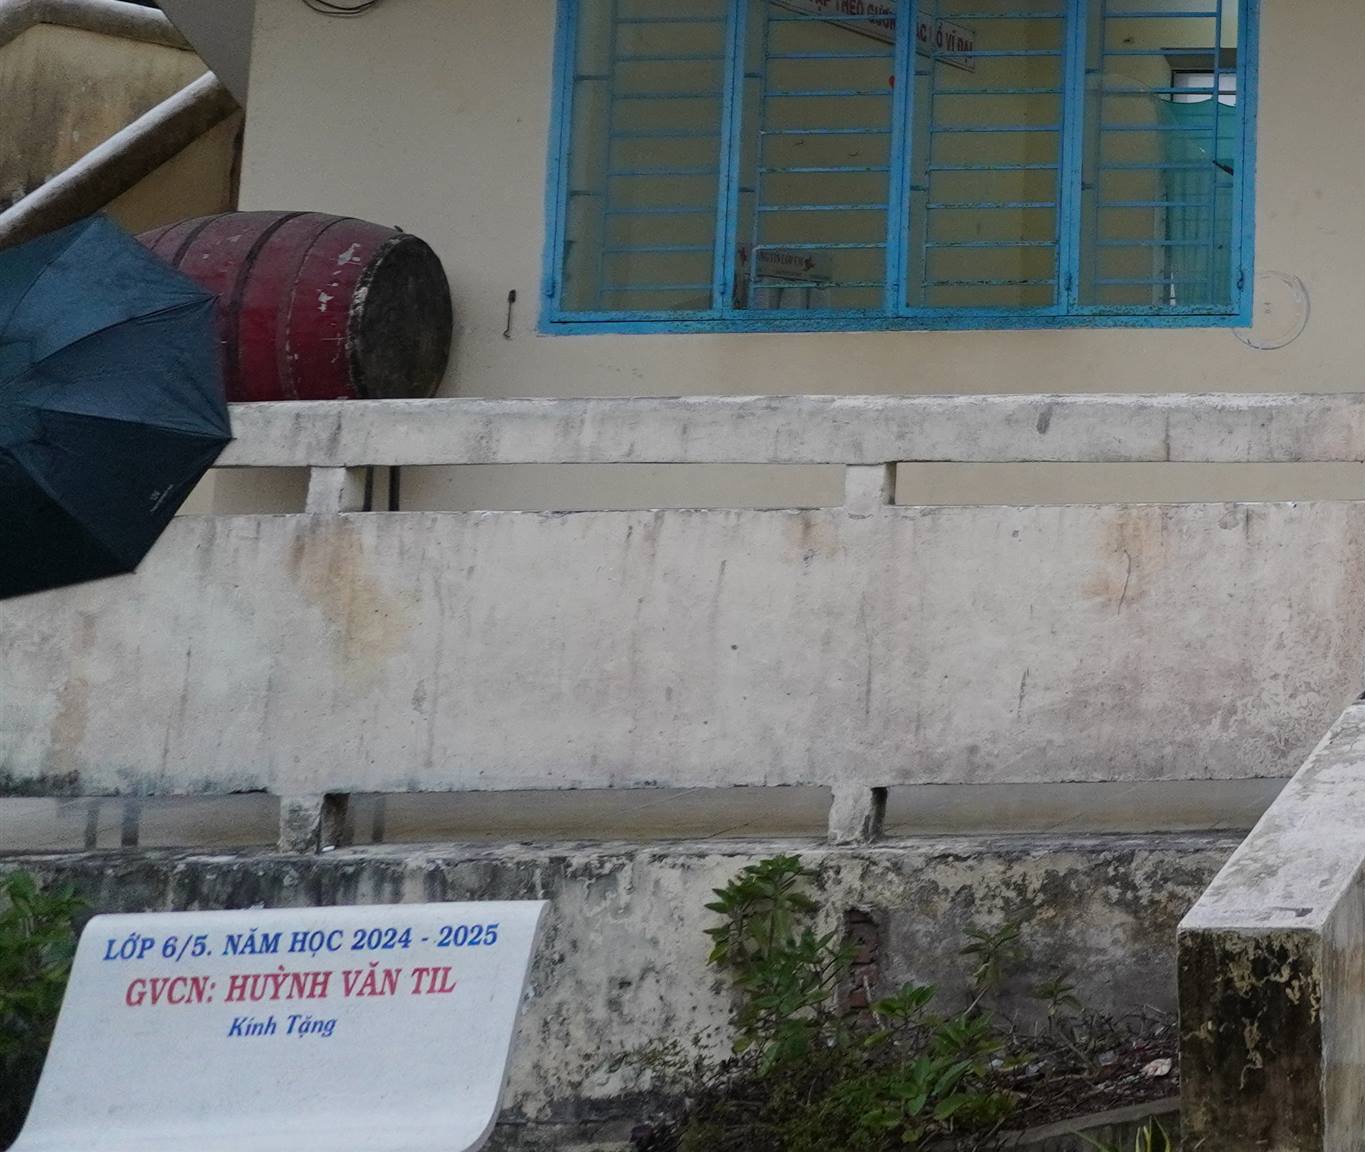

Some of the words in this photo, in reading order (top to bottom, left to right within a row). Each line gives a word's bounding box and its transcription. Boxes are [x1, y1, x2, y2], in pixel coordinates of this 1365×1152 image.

[103, 932, 155, 961] LỚP
[162, 934, 212, 962] 6/5.
[221, 928, 282, 956] NĂM
[288, 929, 344, 957] HỌC
[351, 927, 412, 951] 2024
[437, 922, 500, 947] 2025
[125, 975, 216, 1007] GVCN:
[224, 964, 333, 1003] HUỲNH
[341, 961, 402, 997] VĂN
[411, 966, 458, 995] TIL
[227, 1015, 278, 1037] Kính
[286, 1014, 338, 1038] Tặng
